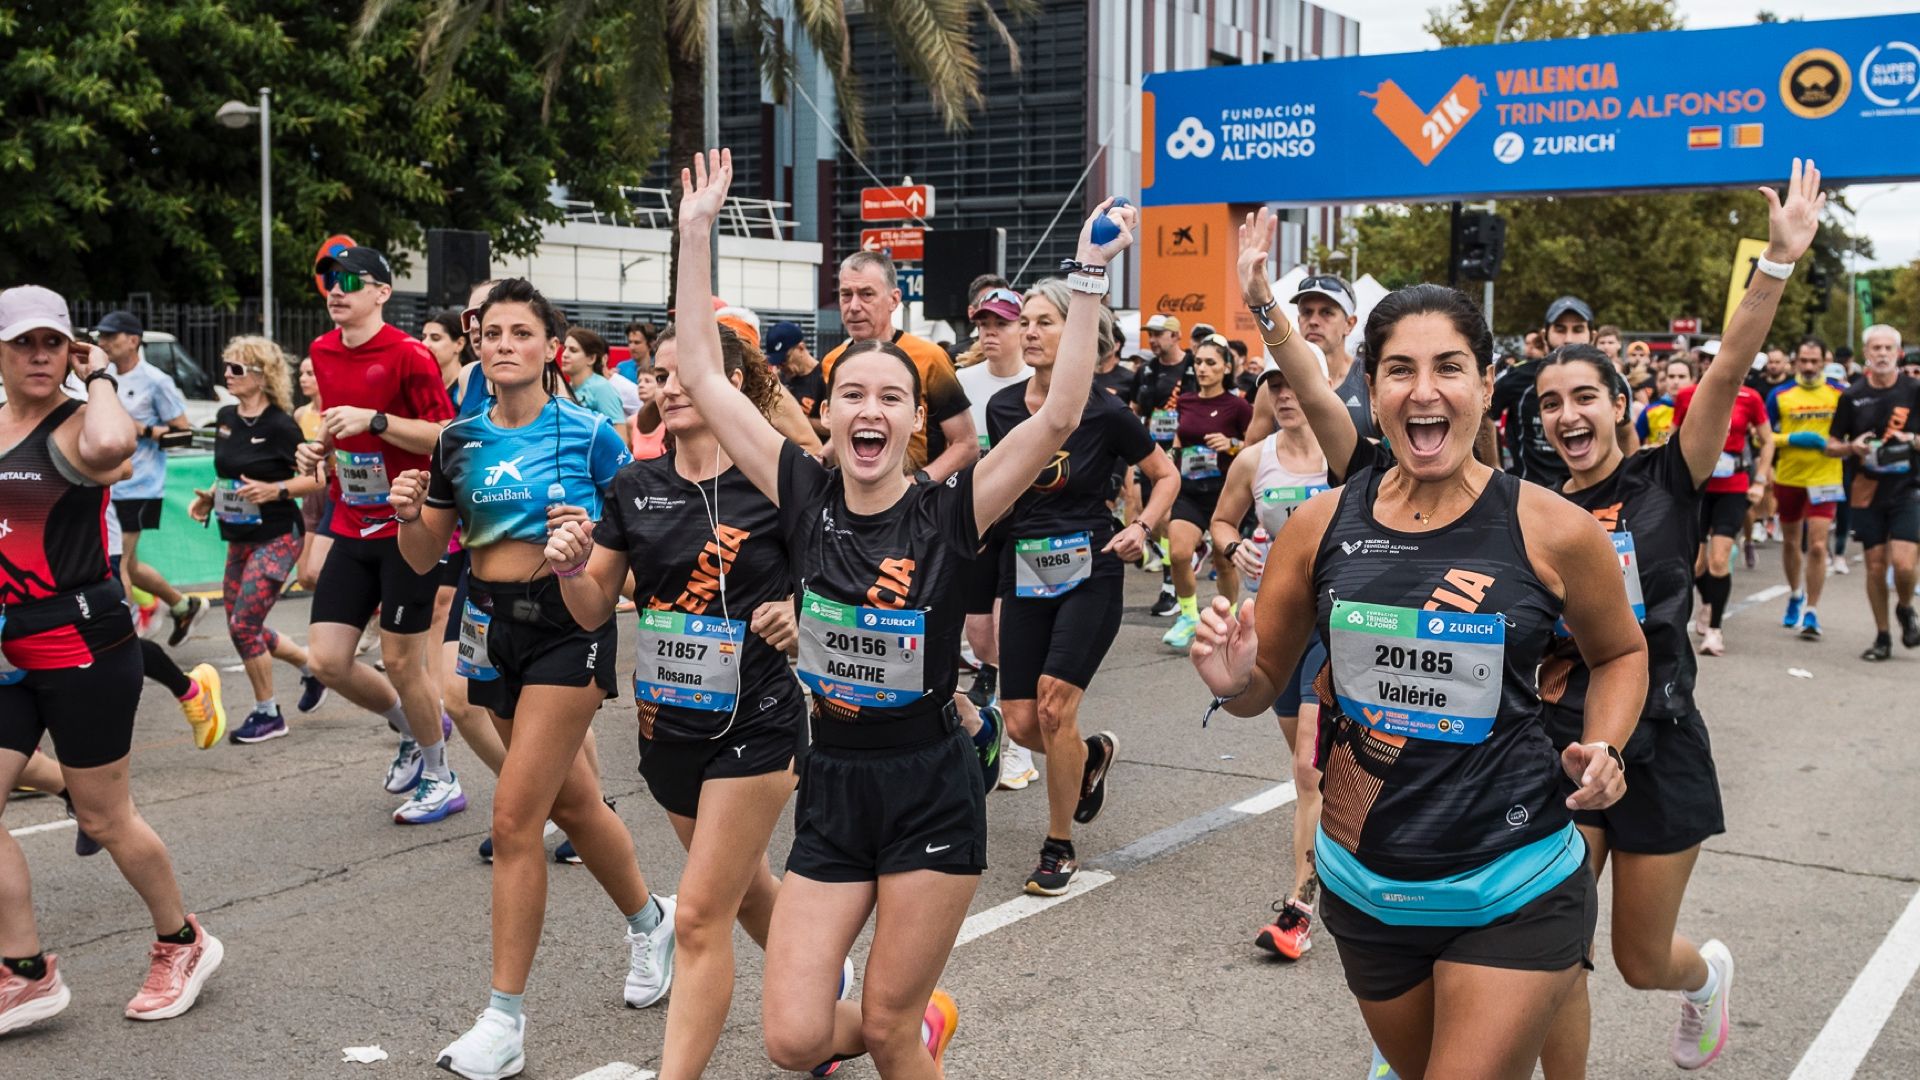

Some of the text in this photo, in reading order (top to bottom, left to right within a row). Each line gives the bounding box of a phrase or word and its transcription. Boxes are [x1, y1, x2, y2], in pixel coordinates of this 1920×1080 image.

[1495, 62, 1618, 96] VALENCIA
[1221, 103, 1315, 121] FUNDACIÓN
[1495, 88, 1767, 126] TRINIDAD ALFONSO
[1220, 118, 1316, 142] TRINIDAD
[1421, 92, 1470, 149] 21K
[1221, 138, 1316, 161] ALFONSO
[1532, 133, 1616, 156] ZURICH
[472, 487, 533, 504] CaixaBank
[1035, 553, 1070, 568] 19268
[706, 624, 737, 635] ZURICH
[880, 616, 916, 627] ZURICH
[1449, 622, 1494, 635] ZURICH
[586, 642, 598, 669] FILA
[657, 639, 709, 661] 21857
[825, 631, 887, 657] 20156
[1375, 644, 1453, 675] 20185
[657, 666, 703, 686] Rosana
[826, 660, 885, 684] AGATHE
[1478, 668, 1484, 676] 8
[1378, 680, 1448, 708] Valérie
